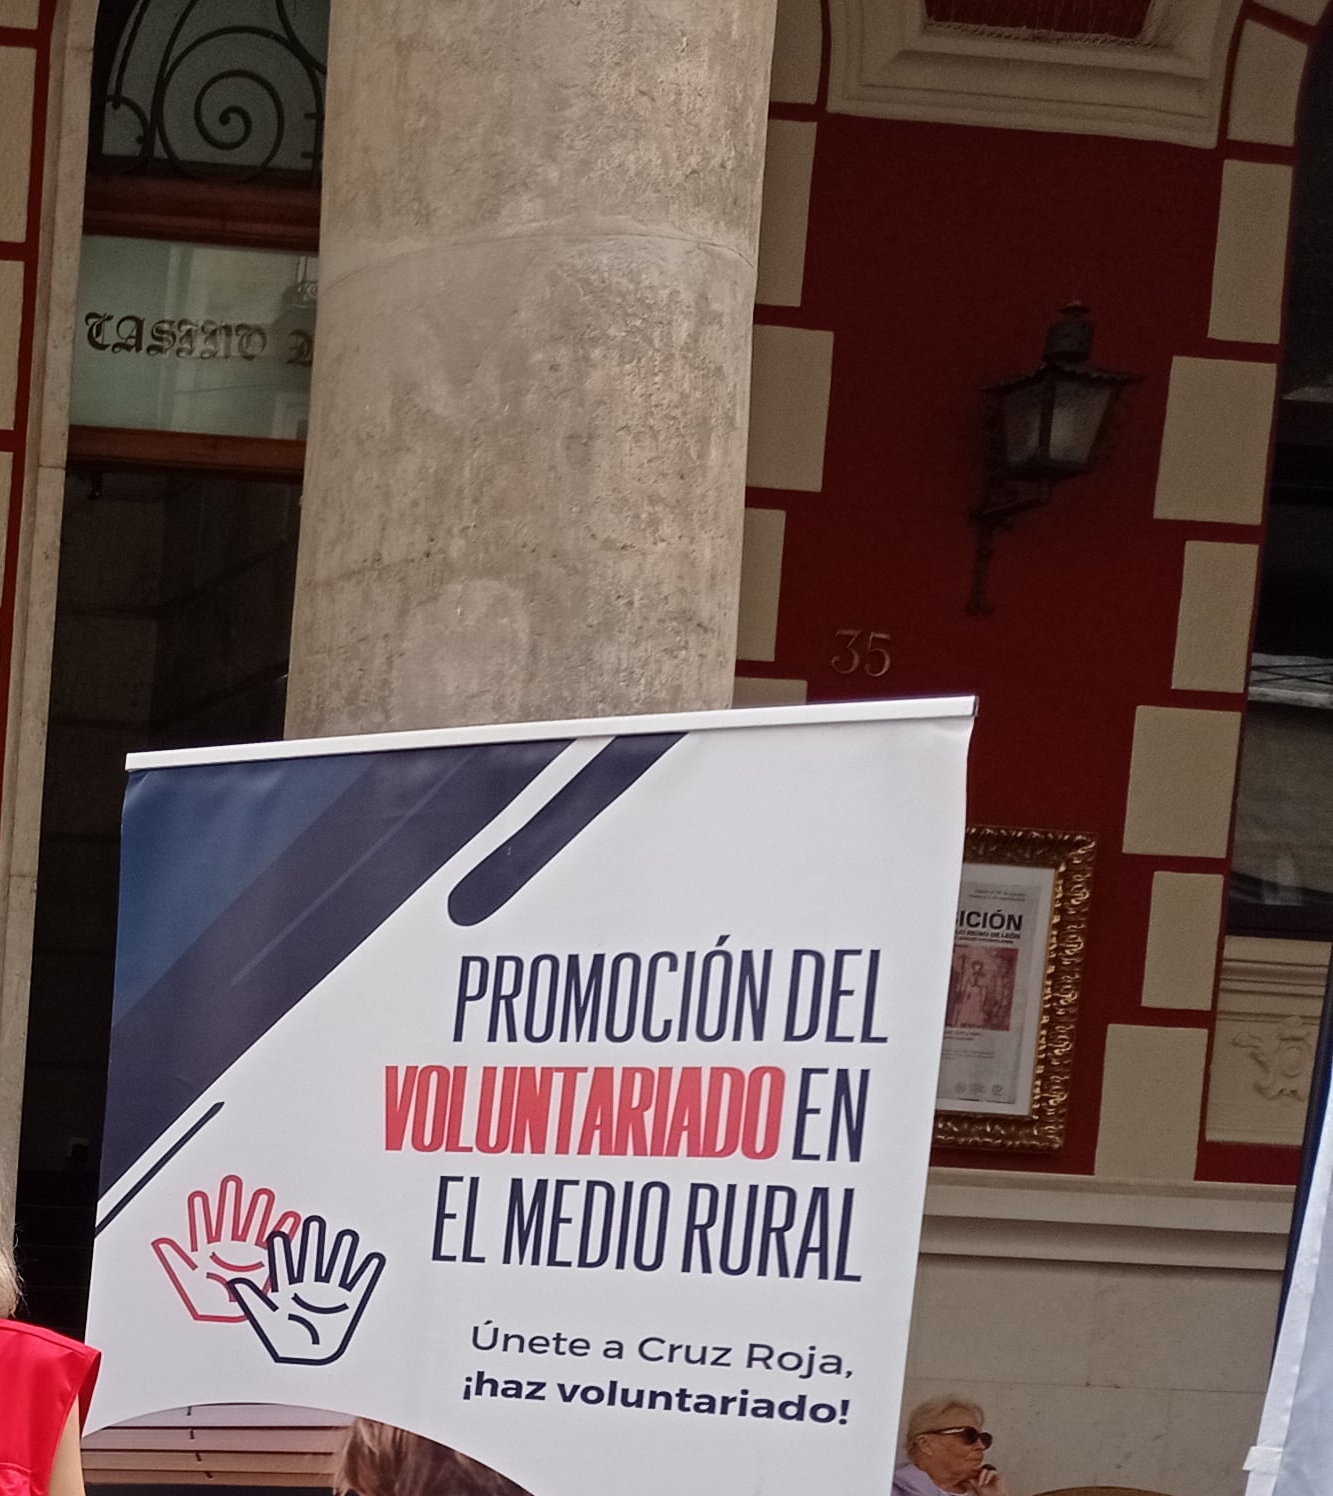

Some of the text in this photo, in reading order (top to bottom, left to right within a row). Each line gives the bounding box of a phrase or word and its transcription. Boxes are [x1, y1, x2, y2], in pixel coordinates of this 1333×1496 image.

[831, 629, 891, 677] 35
[958, 909, 1023, 931] ICIÓN
[452, 934, 889, 1045] PROMOCIÓN DEL
[384, 1065, 871, 1163] VOLUNTARIADO EN
[431, 1176, 863, 1283] EL MEDIO RURAL
[471, 1320, 854, 1380] Únete a Cruz Roja,
[462, 1371, 851, 1426] ¡haz voluntariado!
